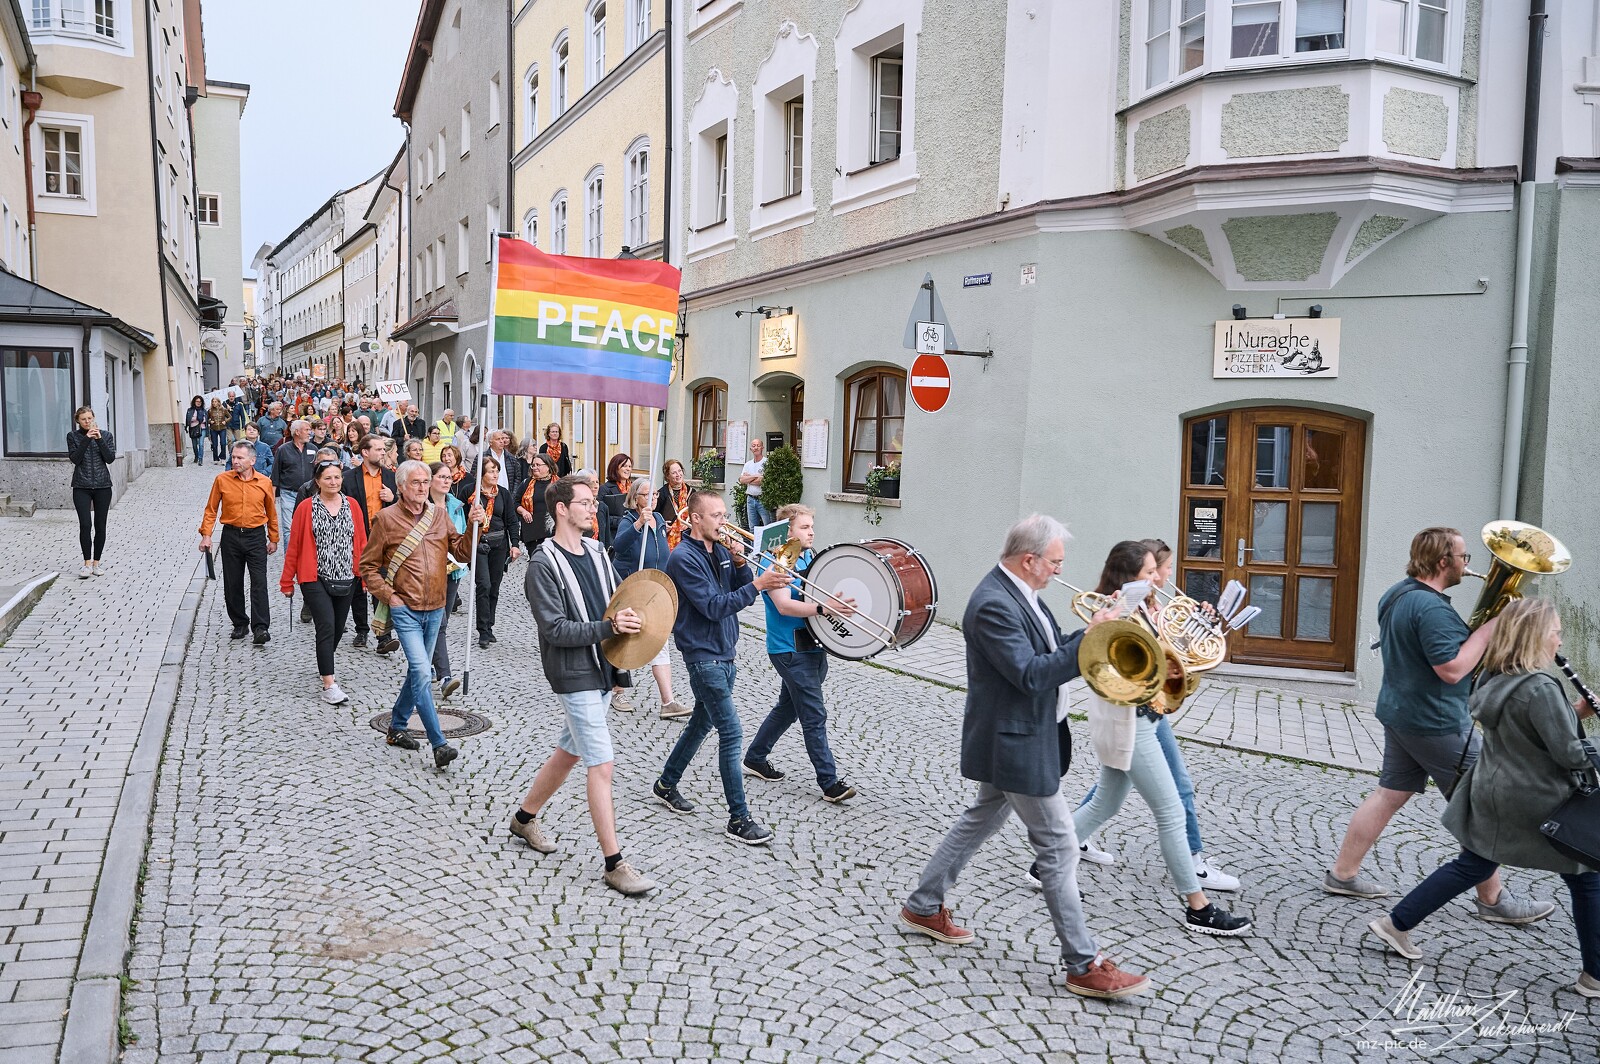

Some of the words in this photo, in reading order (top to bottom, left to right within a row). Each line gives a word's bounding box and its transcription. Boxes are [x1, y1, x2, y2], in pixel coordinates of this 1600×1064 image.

[537, 300, 673, 356] PEACE
[1224, 325, 1233, 348] Il
[1238, 323, 1310, 356] Nuraghe
[926, 343, 936, 351] frei
[1231, 353, 1277, 363] PIZZERIA
[1230, 364, 1276, 374] OSTERIA
